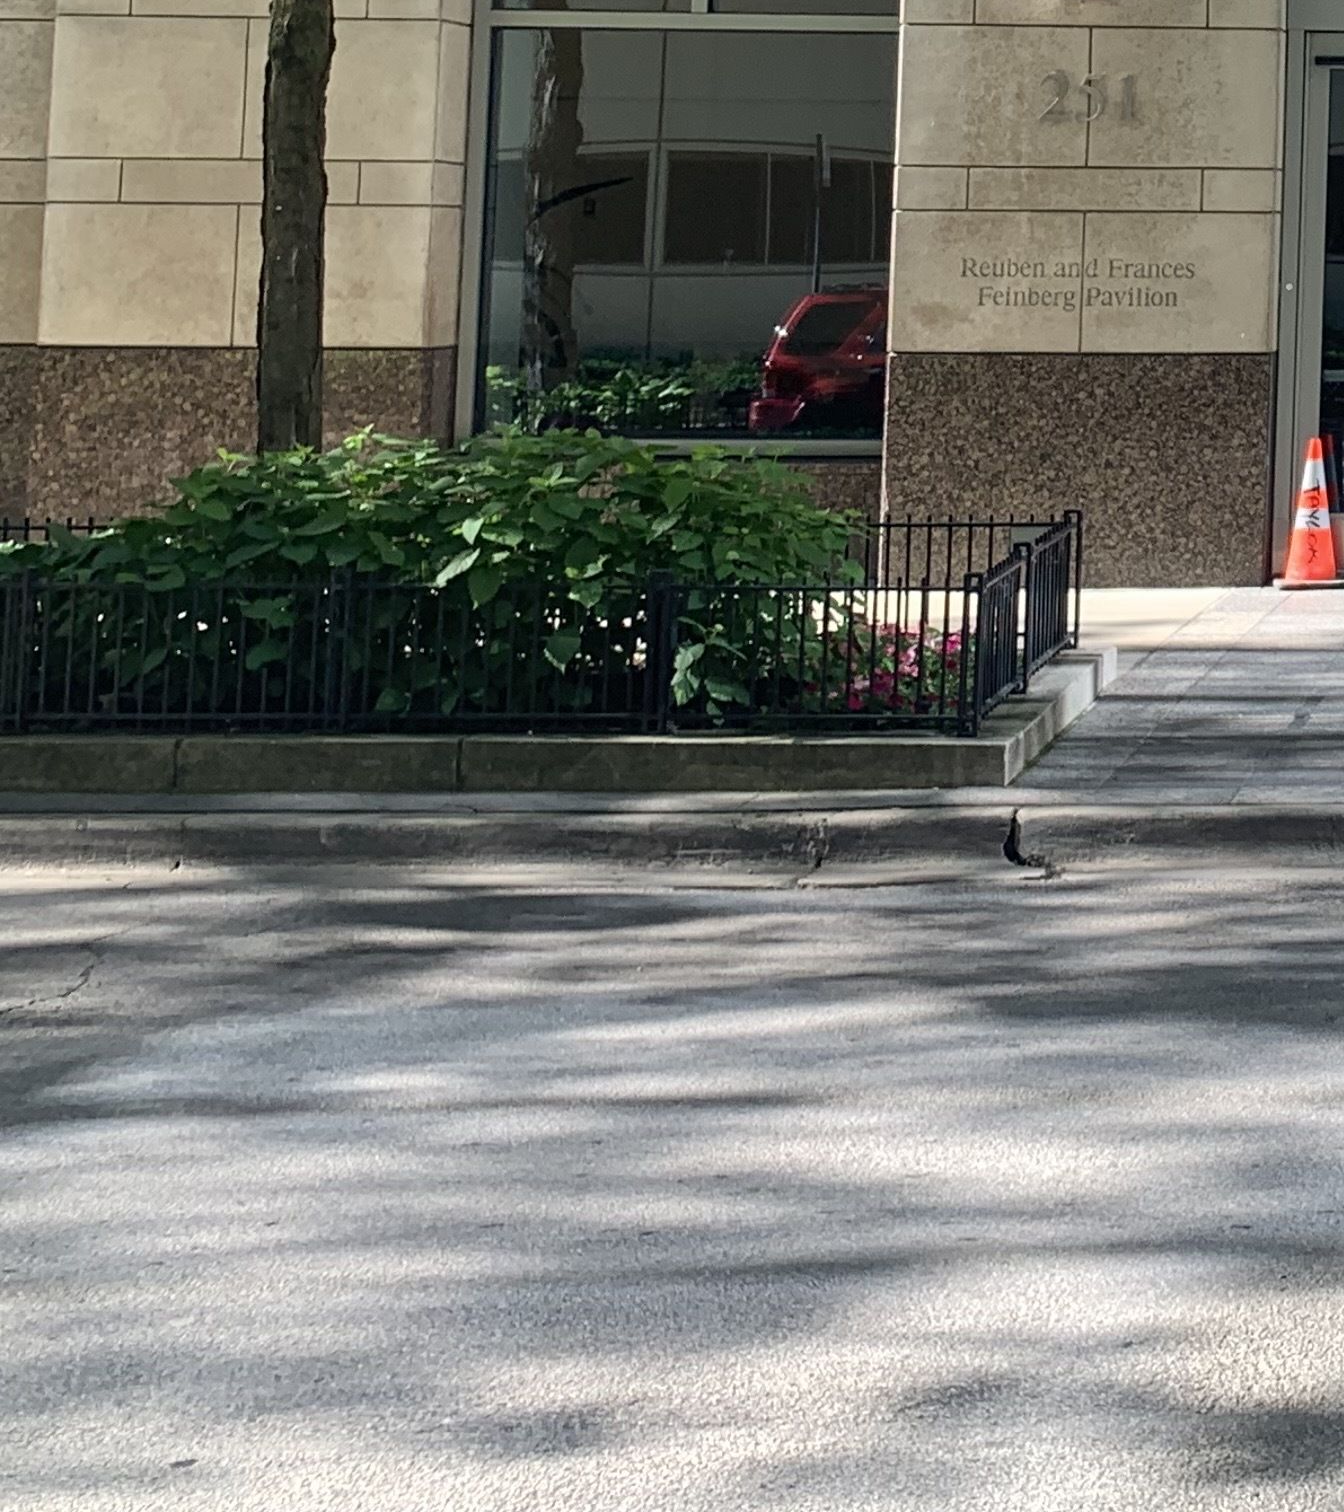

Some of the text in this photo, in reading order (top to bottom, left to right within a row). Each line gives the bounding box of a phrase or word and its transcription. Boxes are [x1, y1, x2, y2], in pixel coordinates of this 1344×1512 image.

[1037, 69, 1140, 123] 251
[960, 257, 1196, 280] Reuben and Frances
[977, 287, 1178, 312] Feinberg Pavilion
